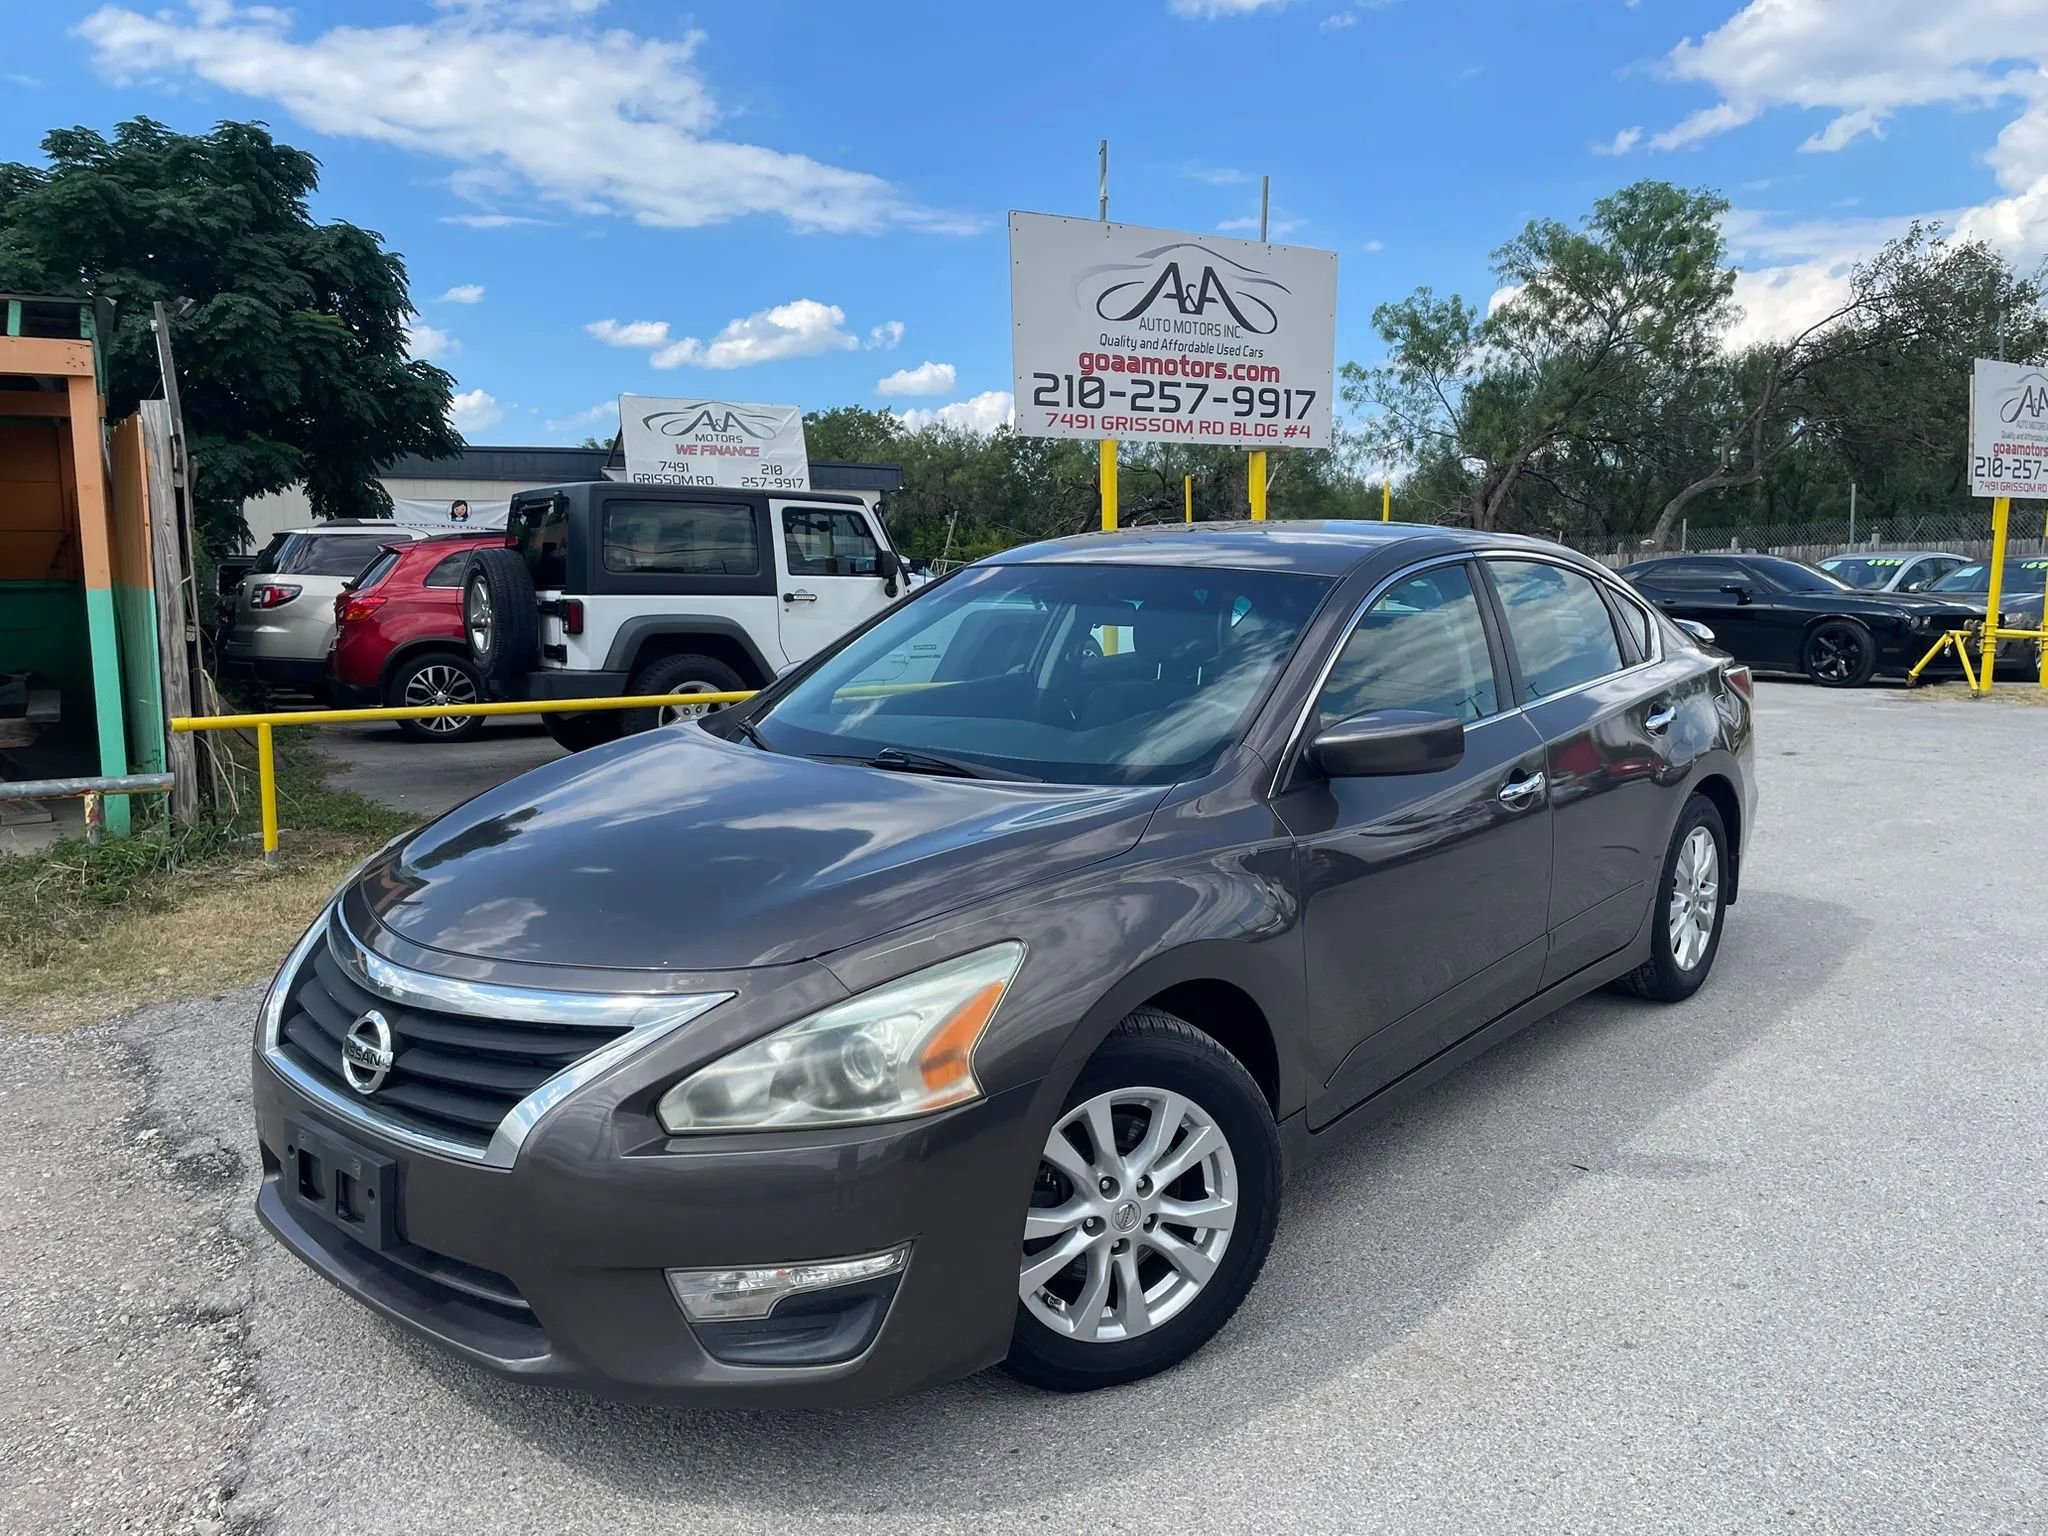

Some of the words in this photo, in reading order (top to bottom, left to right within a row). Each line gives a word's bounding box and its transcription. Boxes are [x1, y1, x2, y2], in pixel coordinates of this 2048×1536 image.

[1139, 316, 1171, 333] AUTO
[1174, 319, 1221, 337] MOTORS
[1224, 324, 1243, 339] INC.
[1099, 333, 1137, 351] Quality
[1140, 338, 1158, 350] and
[1160, 338, 1214, 355] Affordable
[1216, 344, 1241, 357] Used
[1243, 347, 1264, 359] Cars
[1079, 352, 1280, 383] goaamotors.com
[1033, 372, 1316, 420] 210-257-9917
[1045, 412, 1096, 430] 7491
[1101, 415, 1194, 434] GRISSOM
[1199, 420, 1225, 435] RD
[1230, 422, 1278, 437] BLDG
[1284, 424, 1311, 439] #4
[695, 433, 743, 444] MOTORS
[675, 443, 698, 456] WE
[700, 444, 760, 457] FINANCE
[659, 461, 690, 473] 7491
[761, 463, 783, 476] 210
[633, 472, 694, 486] GRISSOM
[741, 476, 804, 489] 257-9917
[1979, 481, 1999, 490] 7491
[2000, 482, 2036, 492] GRISSOM
